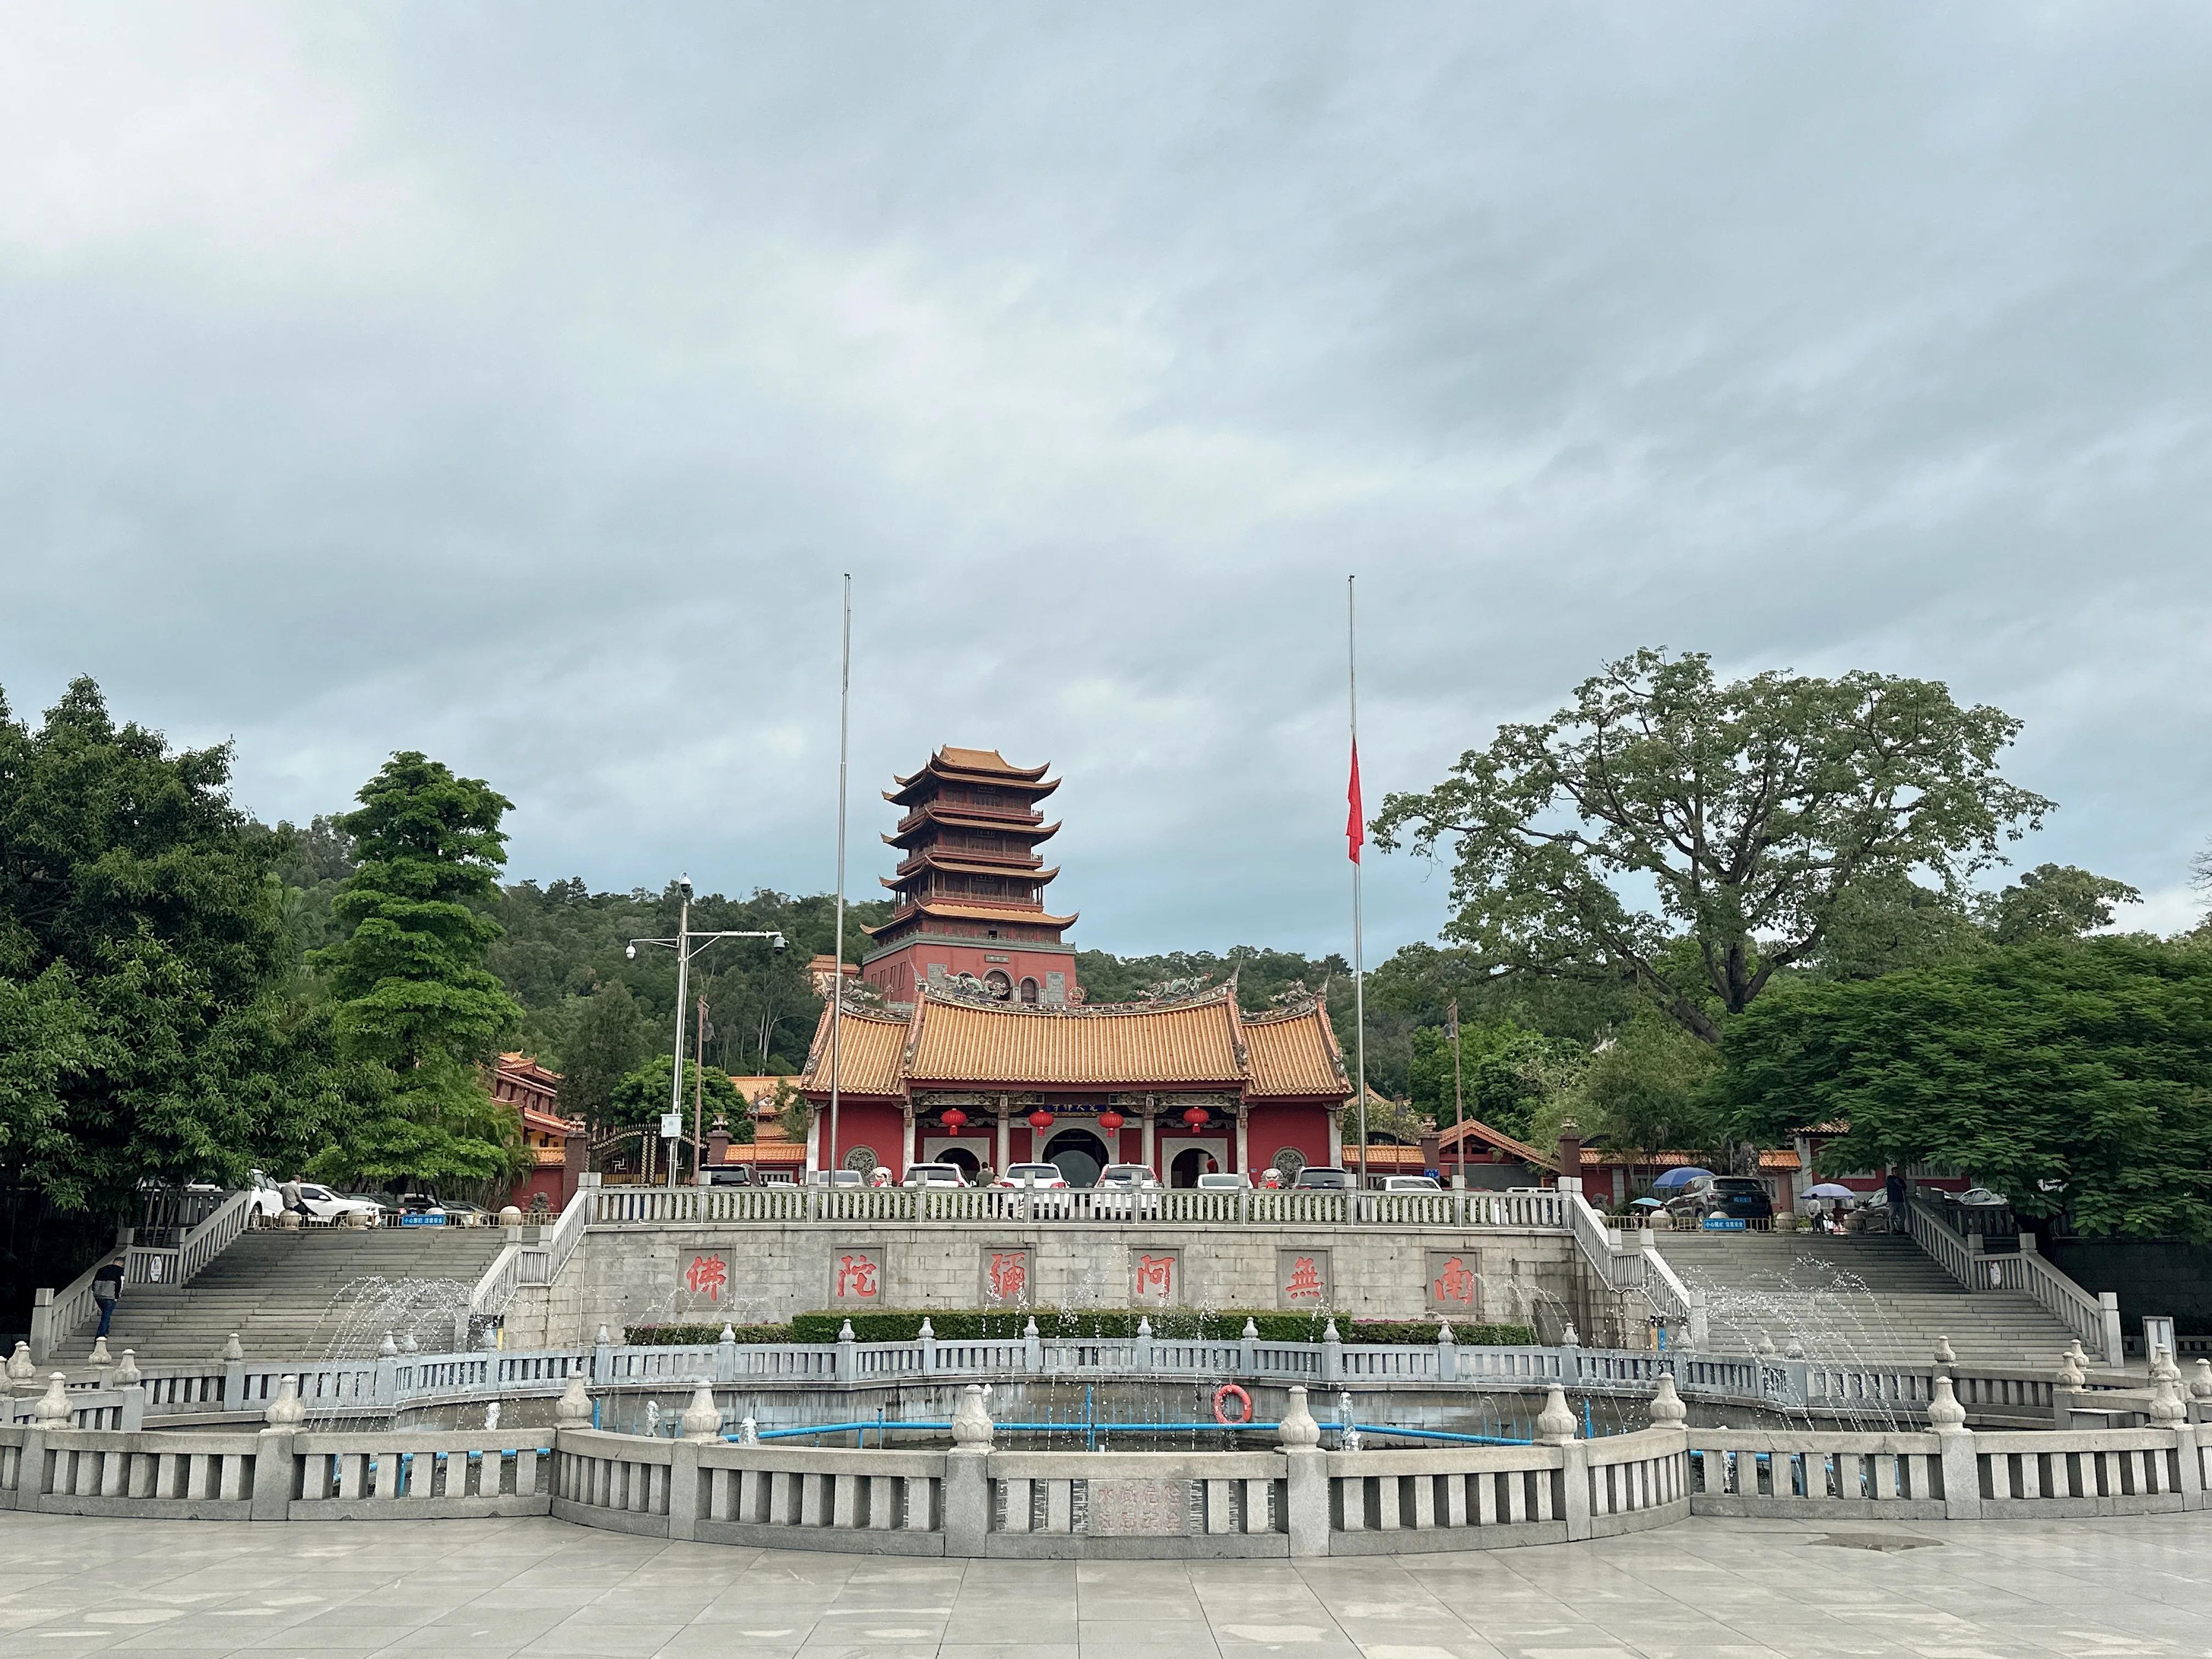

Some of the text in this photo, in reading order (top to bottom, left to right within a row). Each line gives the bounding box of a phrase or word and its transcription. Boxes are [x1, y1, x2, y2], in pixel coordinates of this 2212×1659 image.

[686, 1255, 726, 1301] 佛
[837, 1255, 877, 1298] 陀
[1136, 1255, 1175, 1297] 阿
[1285, 1257, 1323, 1299] 無
[1434, 1257, 1474, 1305] 南
